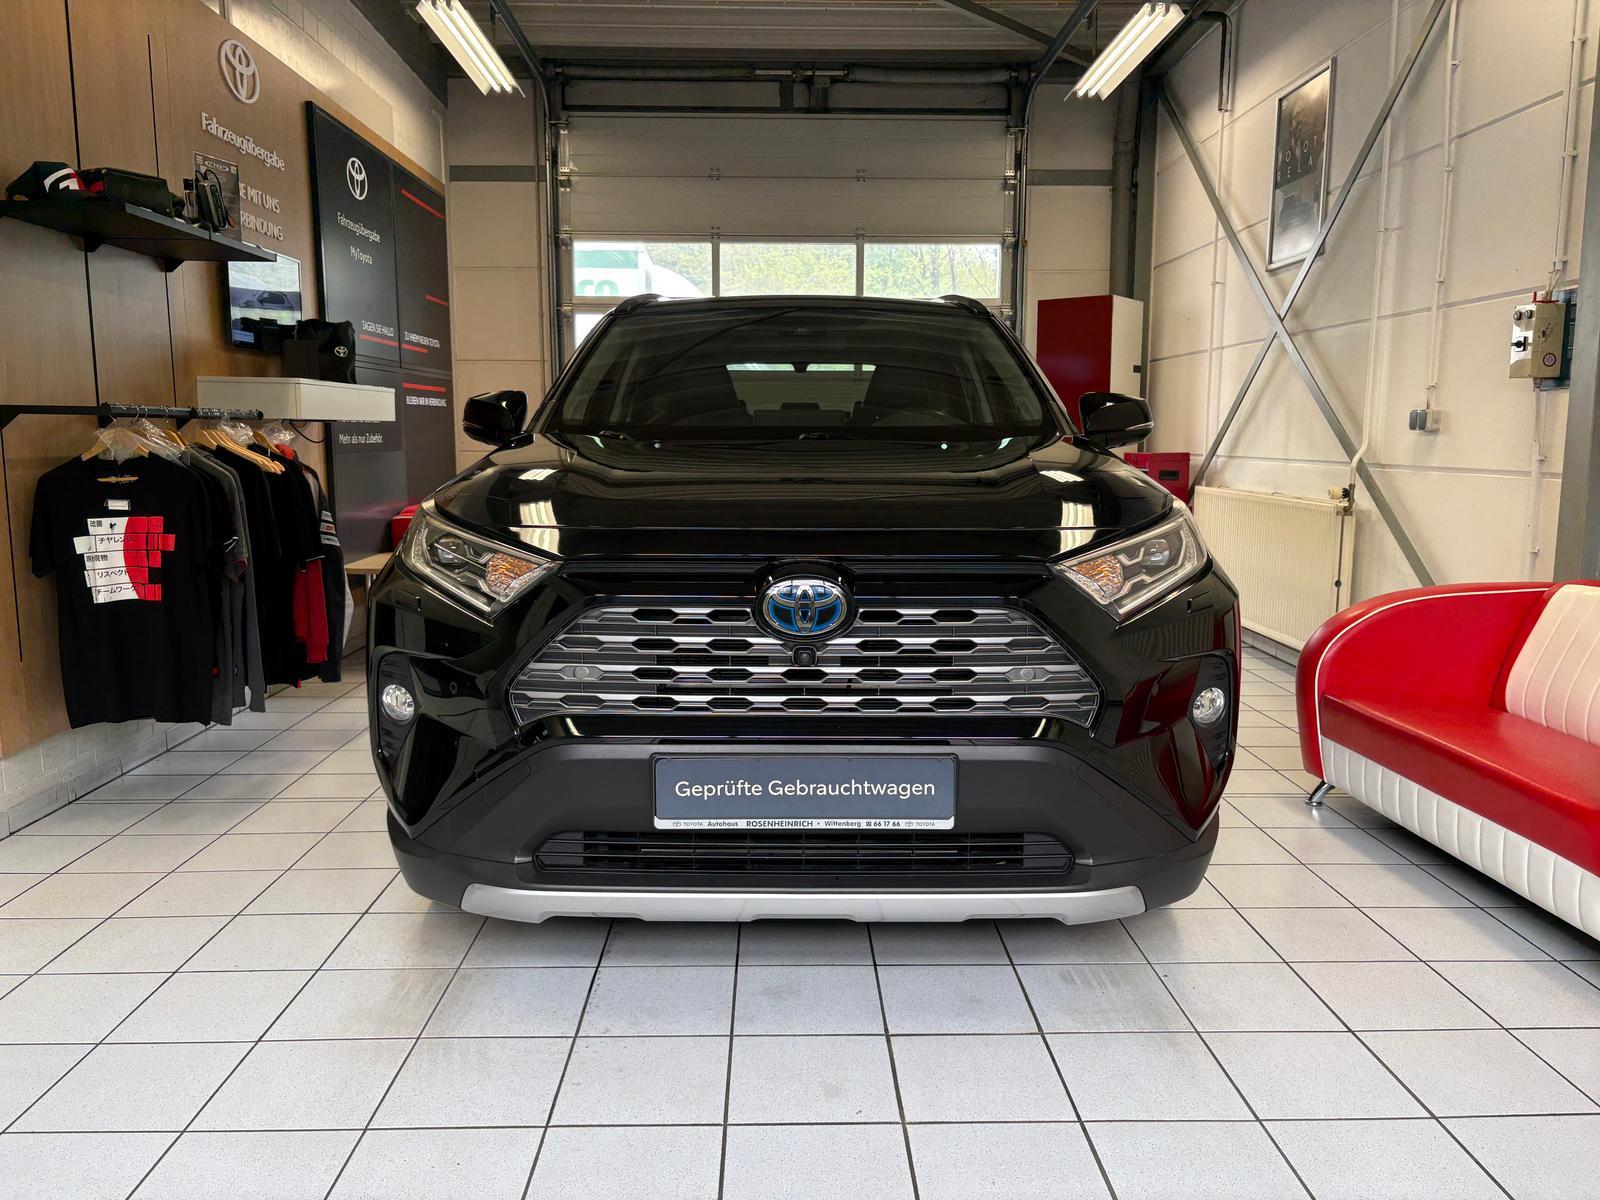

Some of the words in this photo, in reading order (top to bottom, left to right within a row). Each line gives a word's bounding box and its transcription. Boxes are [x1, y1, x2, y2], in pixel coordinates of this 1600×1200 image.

[201, 111, 285, 171] Fahrzeugübergabe
[247, 185, 263, 207] MIT
[263, 191, 280, 213] UNS
[337, 212, 381, 243] Fahrzeugübergabe
[350, 246, 373, 265] MyToyota
[362, 320, 376, 332] SAGEN
[382, 325, 394, 337] HALLO
[339, 433, 351, 444] Mehr
[351, 433, 359, 444] als
[675, 780, 762, 800] Geprüfte
[768, 779, 935, 800] Gebrauchtwagen
[824, 820, 862, 828] Wittenberg
